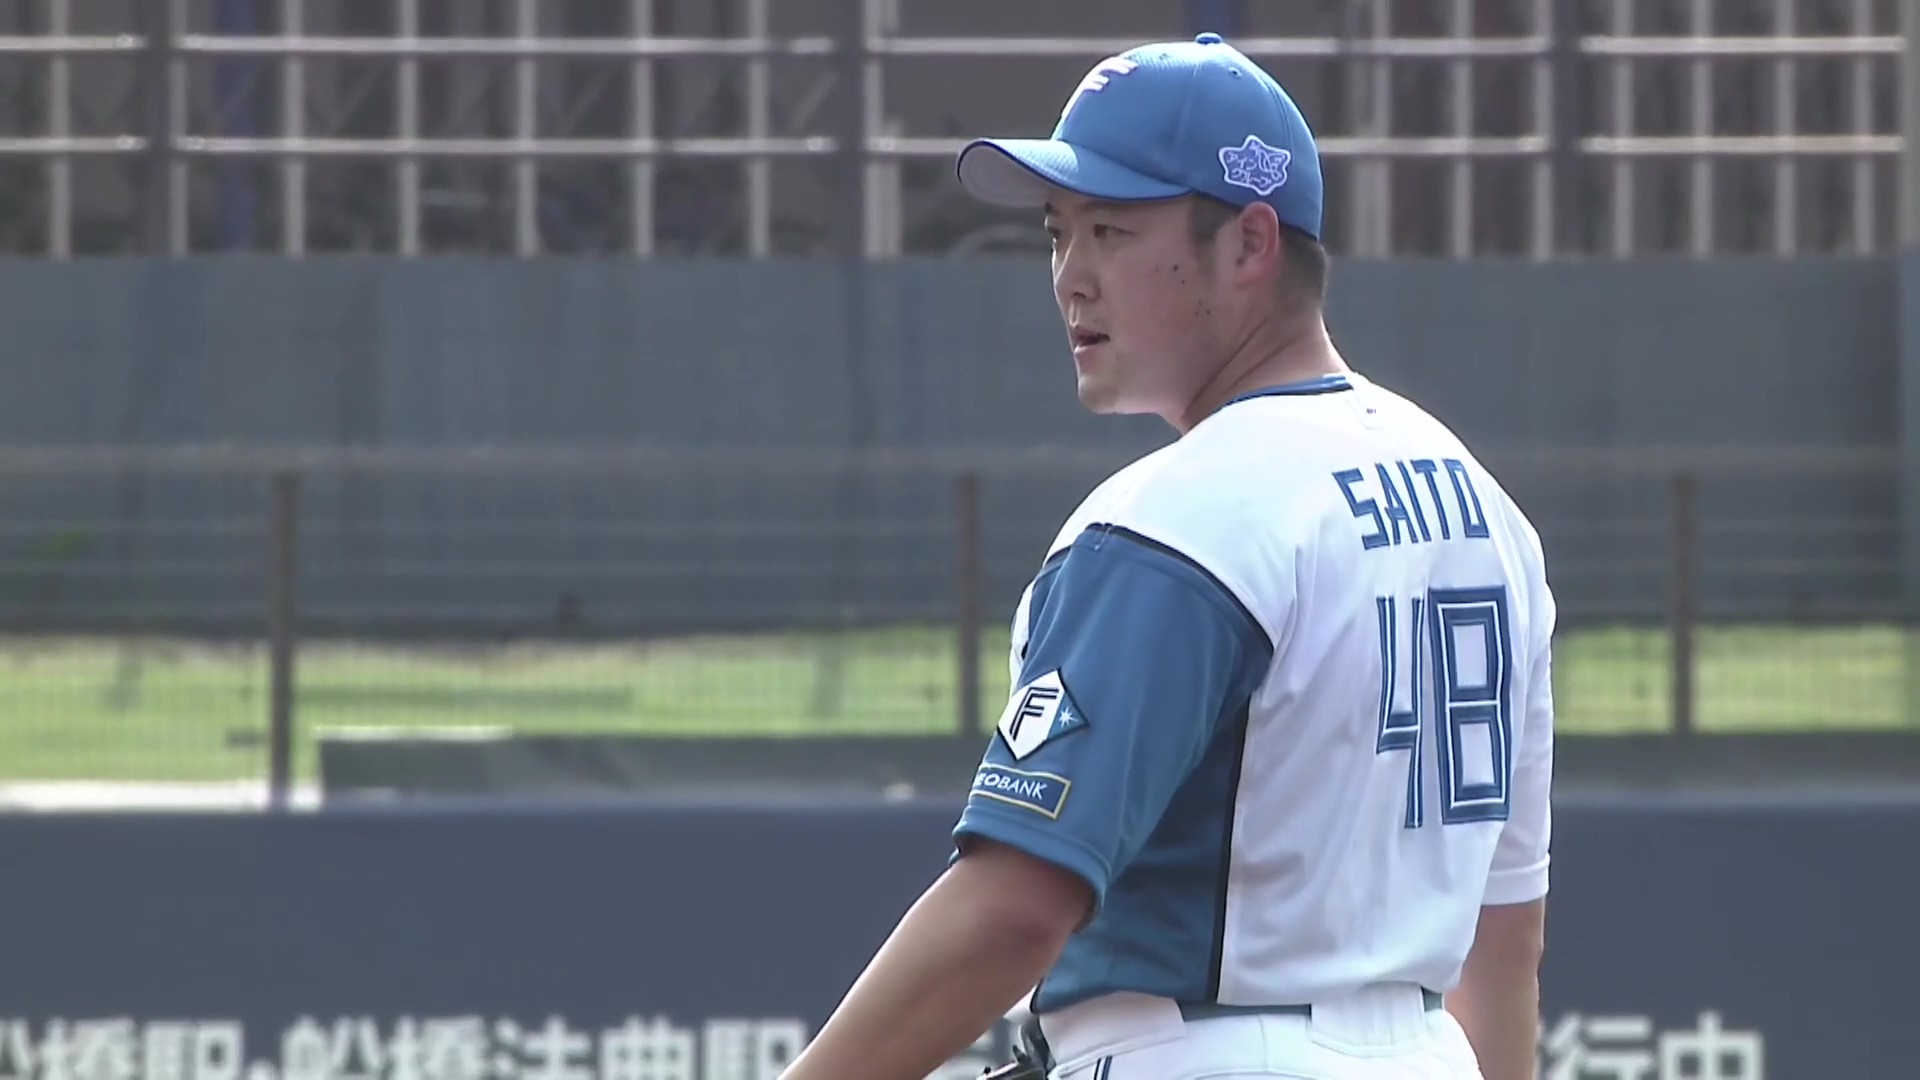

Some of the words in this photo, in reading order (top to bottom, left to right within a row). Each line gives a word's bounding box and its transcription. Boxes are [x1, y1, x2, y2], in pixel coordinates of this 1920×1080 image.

[1332, 458, 1489, 550] SAITO
[1009, 686, 1059, 741] F
[1376, 585, 1512, 828] 48
[974, 772, 1048, 800] EOBANK
